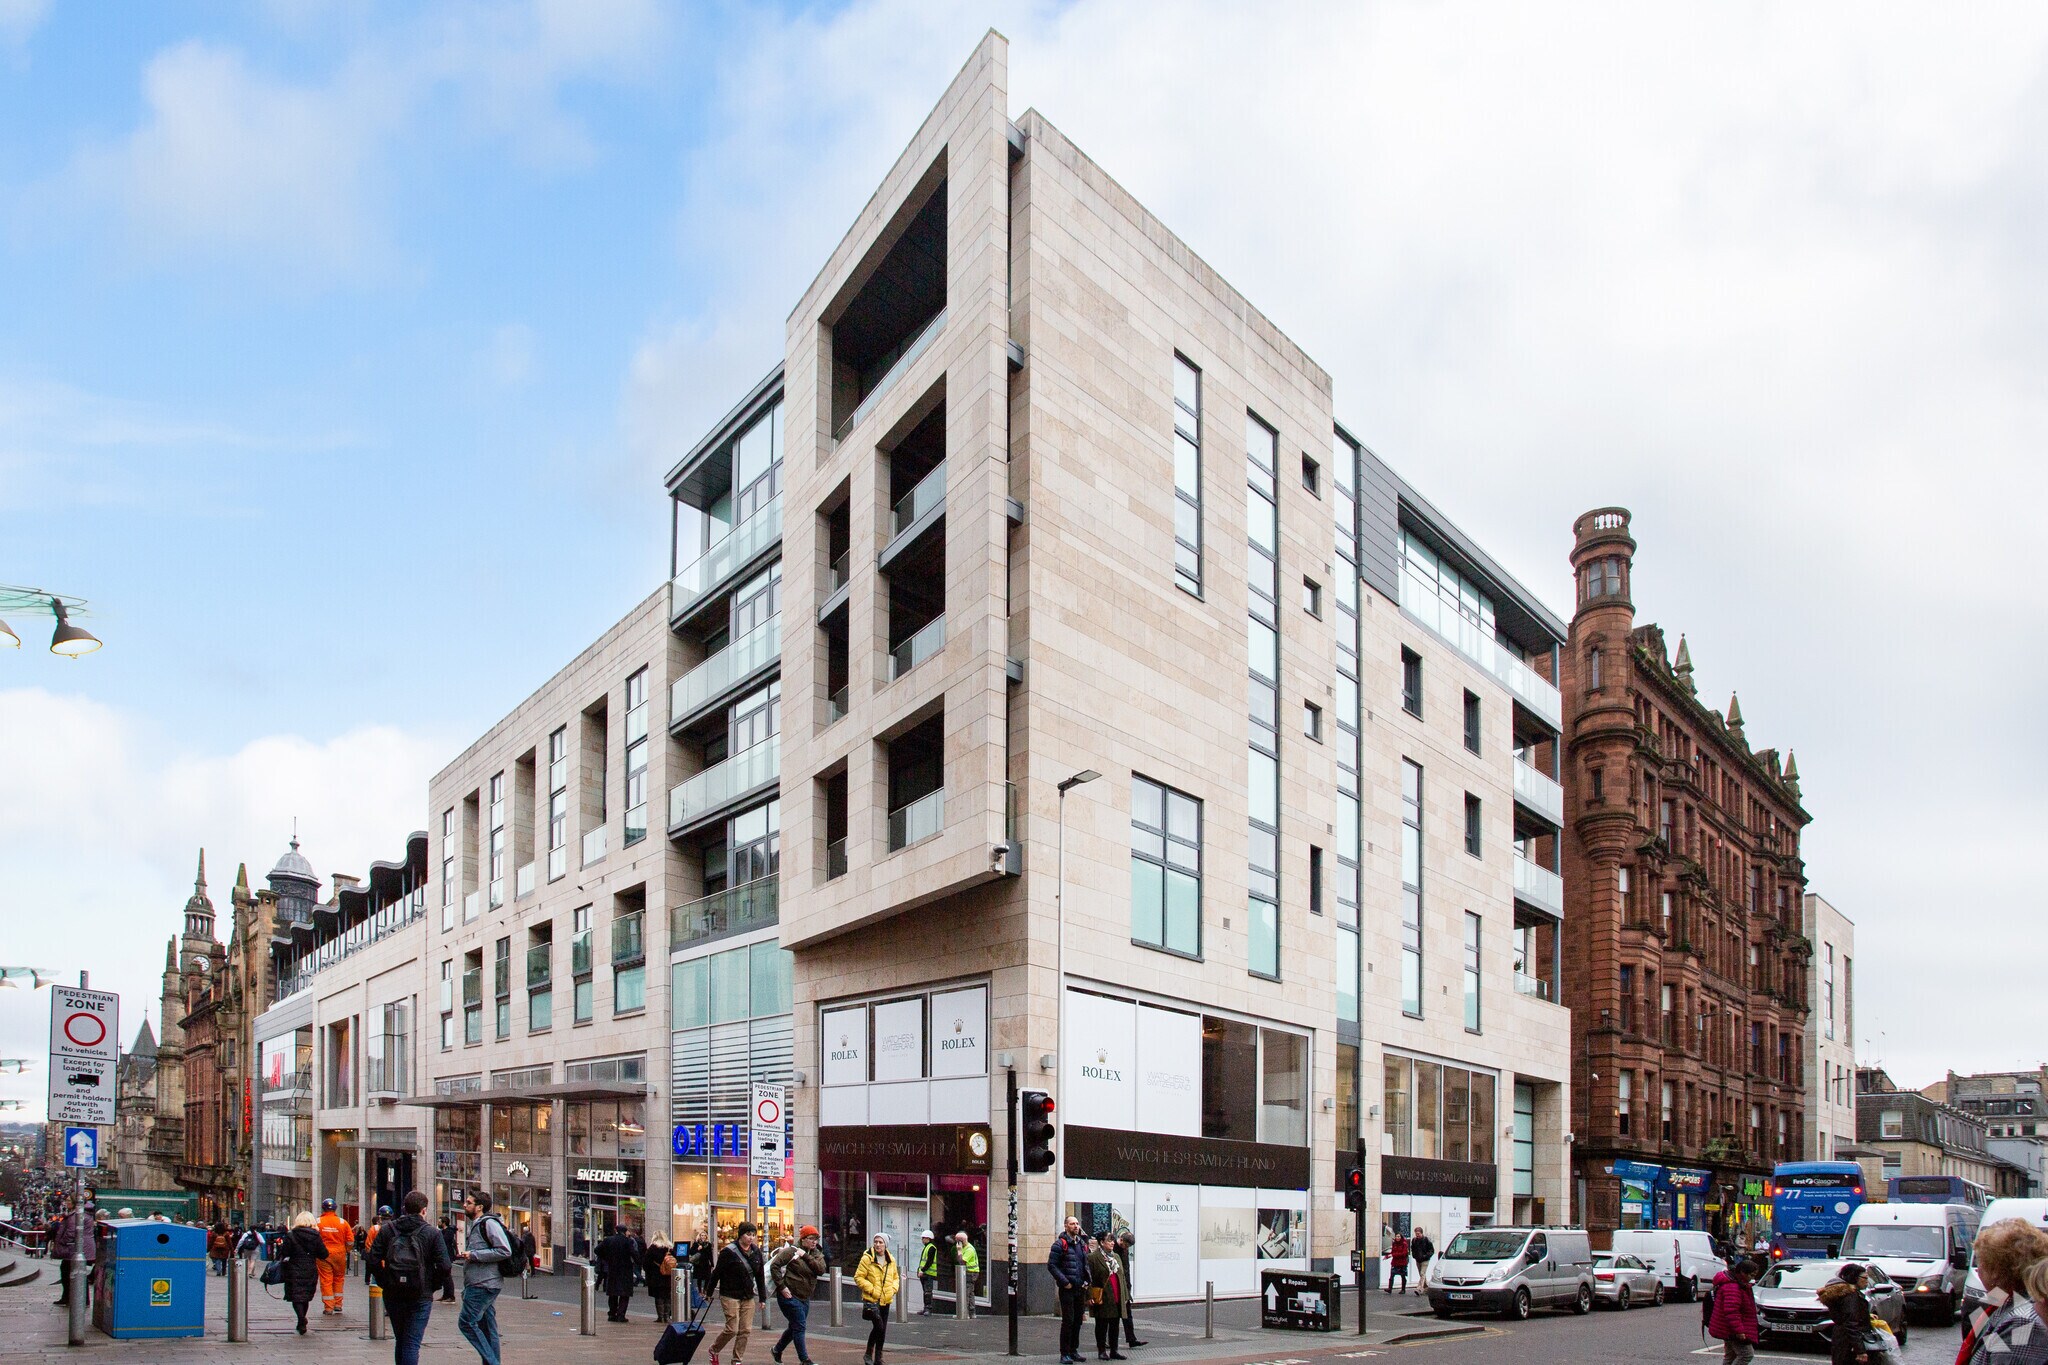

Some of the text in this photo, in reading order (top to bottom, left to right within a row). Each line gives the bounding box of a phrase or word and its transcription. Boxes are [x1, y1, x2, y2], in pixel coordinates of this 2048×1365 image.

[58, 989, 114, 1002] PEDESTRIAN
[66, 998, 105, 1012] ZONE
[942, 1037, 976, 1050] ROLEX
[76, 1048, 108, 1056] vehicles
[831, 1050, 858, 1061] ROLEX
[63, 1058, 91, 1066] Except
[63, 1065, 92, 1074] loading
[1082, 1066, 1122, 1082] ROLEX
[754, 1084, 783, 1092] PEDESTRIAN
[673, 1124, 790, 1157] OFFIE
[1117, 1147, 1183, 1165] WATCHES
[506, 1160, 530, 1178] FATFACE
[577, 1168, 628, 1183] SKECHERS
[1784, 1189, 1801, 1199] 77
[1156, 1204, 1179, 1212] ROLEX
[1288, 1278, 1307, 1286] Repairs
